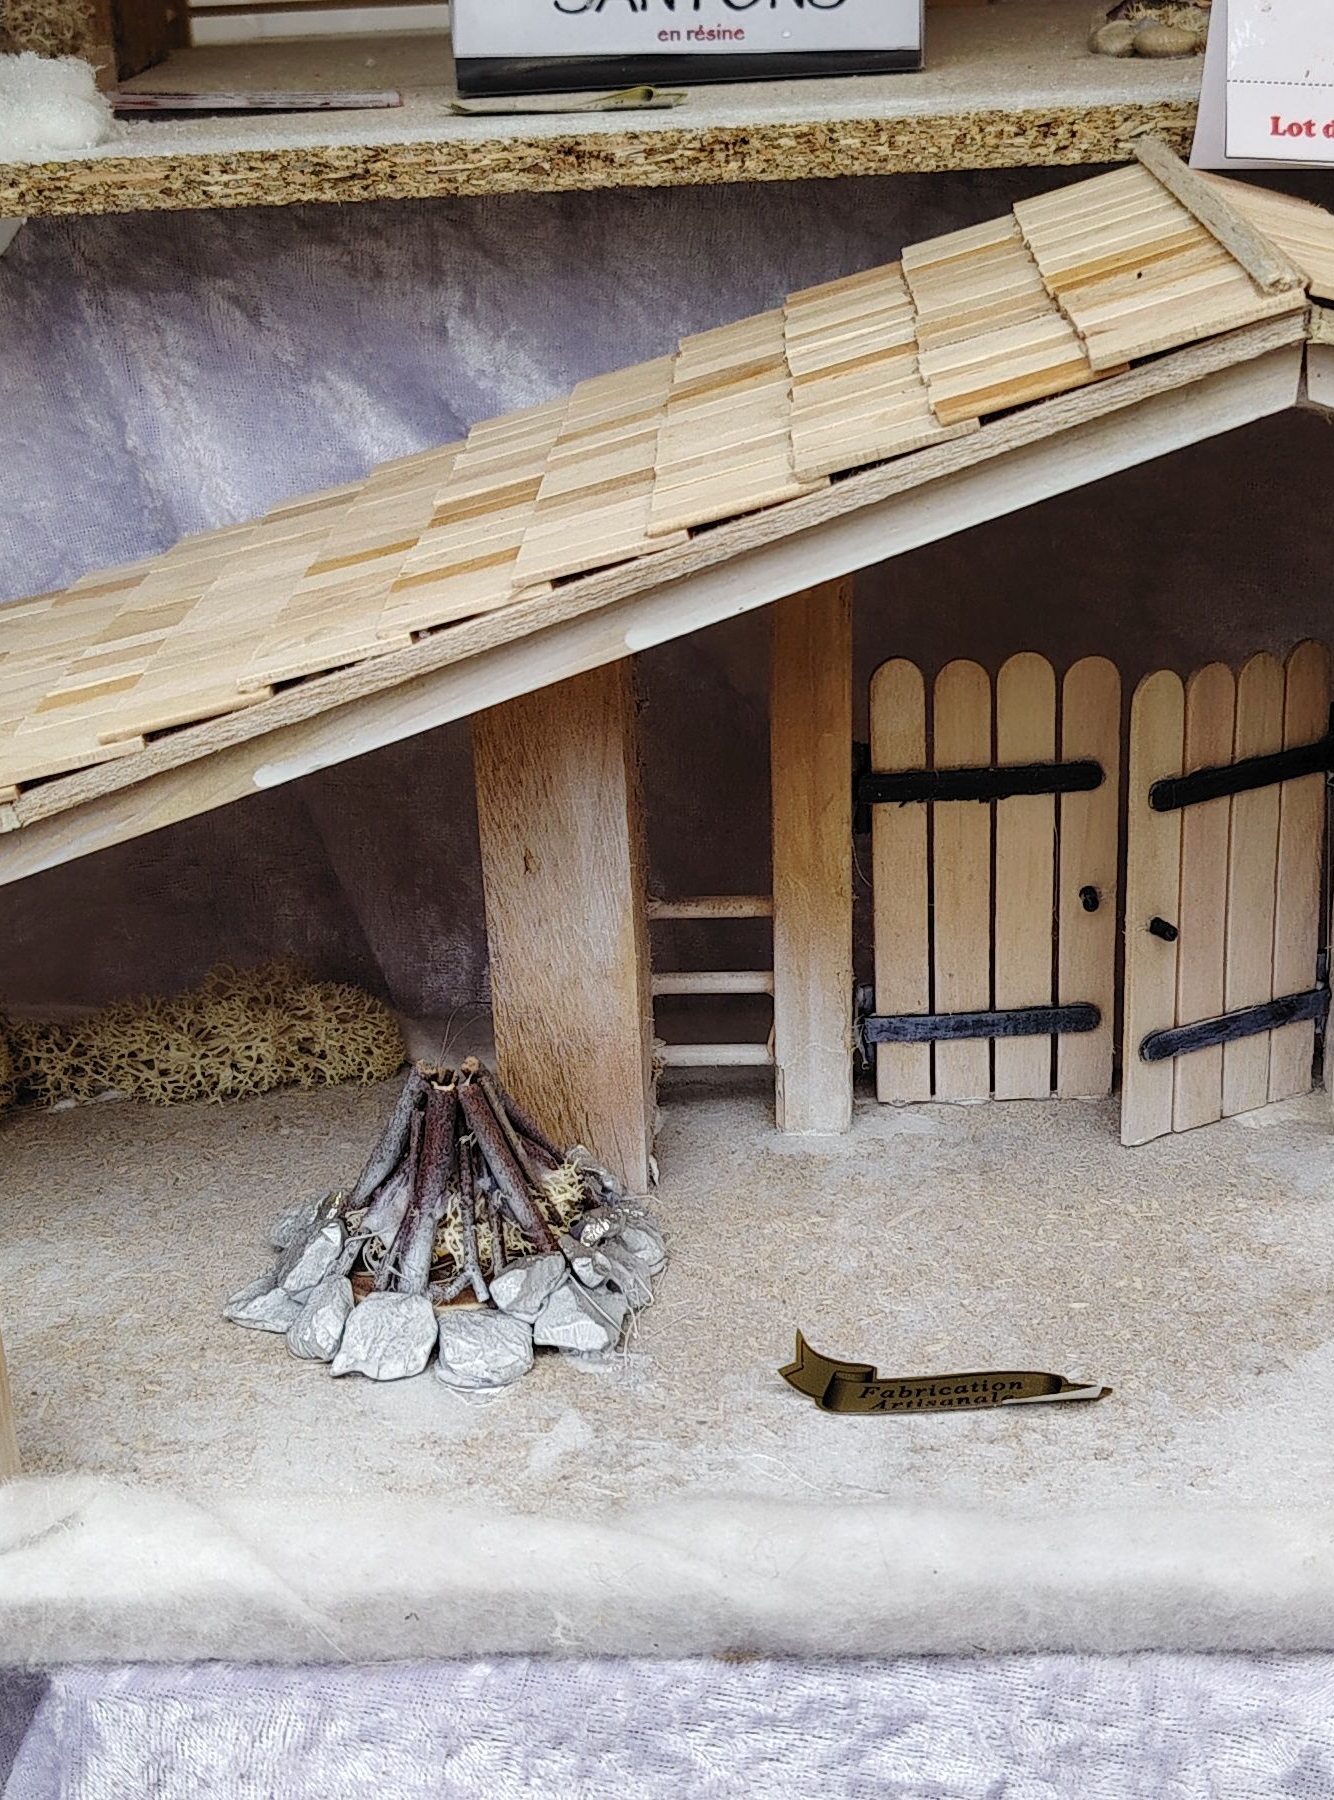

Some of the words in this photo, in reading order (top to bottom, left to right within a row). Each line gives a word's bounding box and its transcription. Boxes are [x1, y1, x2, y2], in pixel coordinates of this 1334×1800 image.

[657, 27, 681, 42] en
[686, 24, 746, 42] résine
[1269, 115, 1317, 138] Lot
[858, 1379, 1024, 1400] Fabrication
